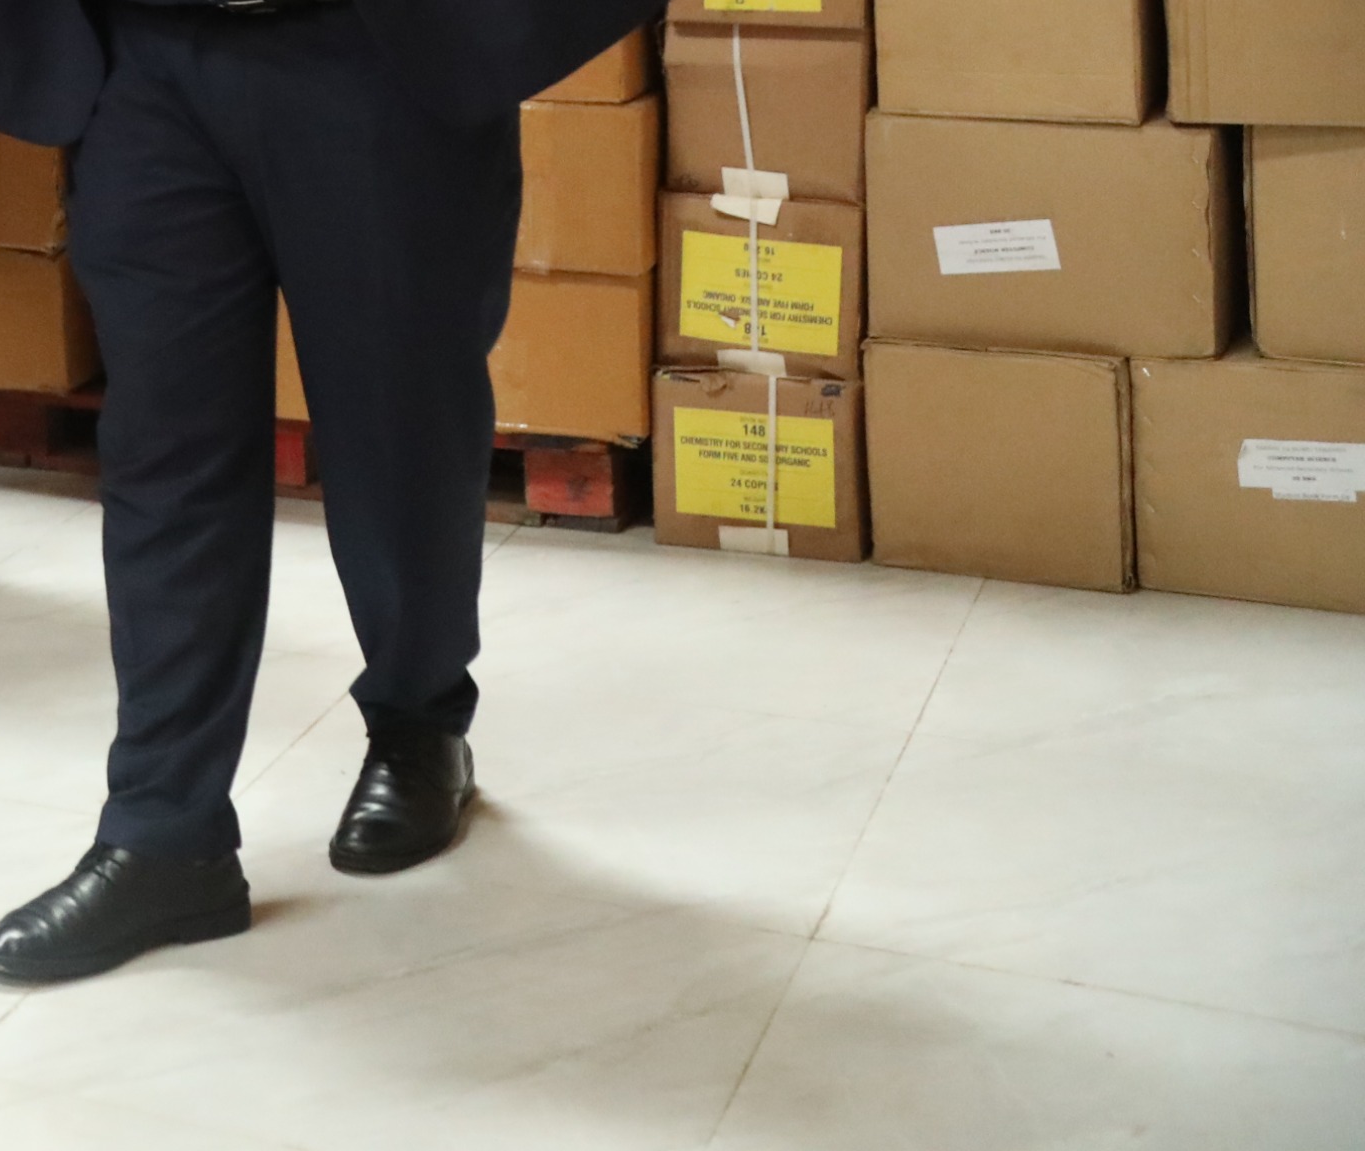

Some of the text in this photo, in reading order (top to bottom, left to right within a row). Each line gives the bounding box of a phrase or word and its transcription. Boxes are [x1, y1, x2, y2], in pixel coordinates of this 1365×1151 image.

[771, 272, 783, 282] 24
[703, 290, 736, 303] ORGANIC
[773, 300, 789, 310] FIVE
[790, 301, 814, 312] FORM
[769, 312, 786, 322] FOR
[787, 314, 833, 326] CHEMISTRY
[744, 323, 766, 336] 18
[742, 424, 766, 437] 148
[680, 435, 723, 448] CHEMISTRY
[724, 438, 741, 448] FOR
[790, 445, 828, 457] SCHOOLS
[698, 450, 811, 468] FORM FIVE AND ORGANIC
[730, 478, 742, 488] 24
